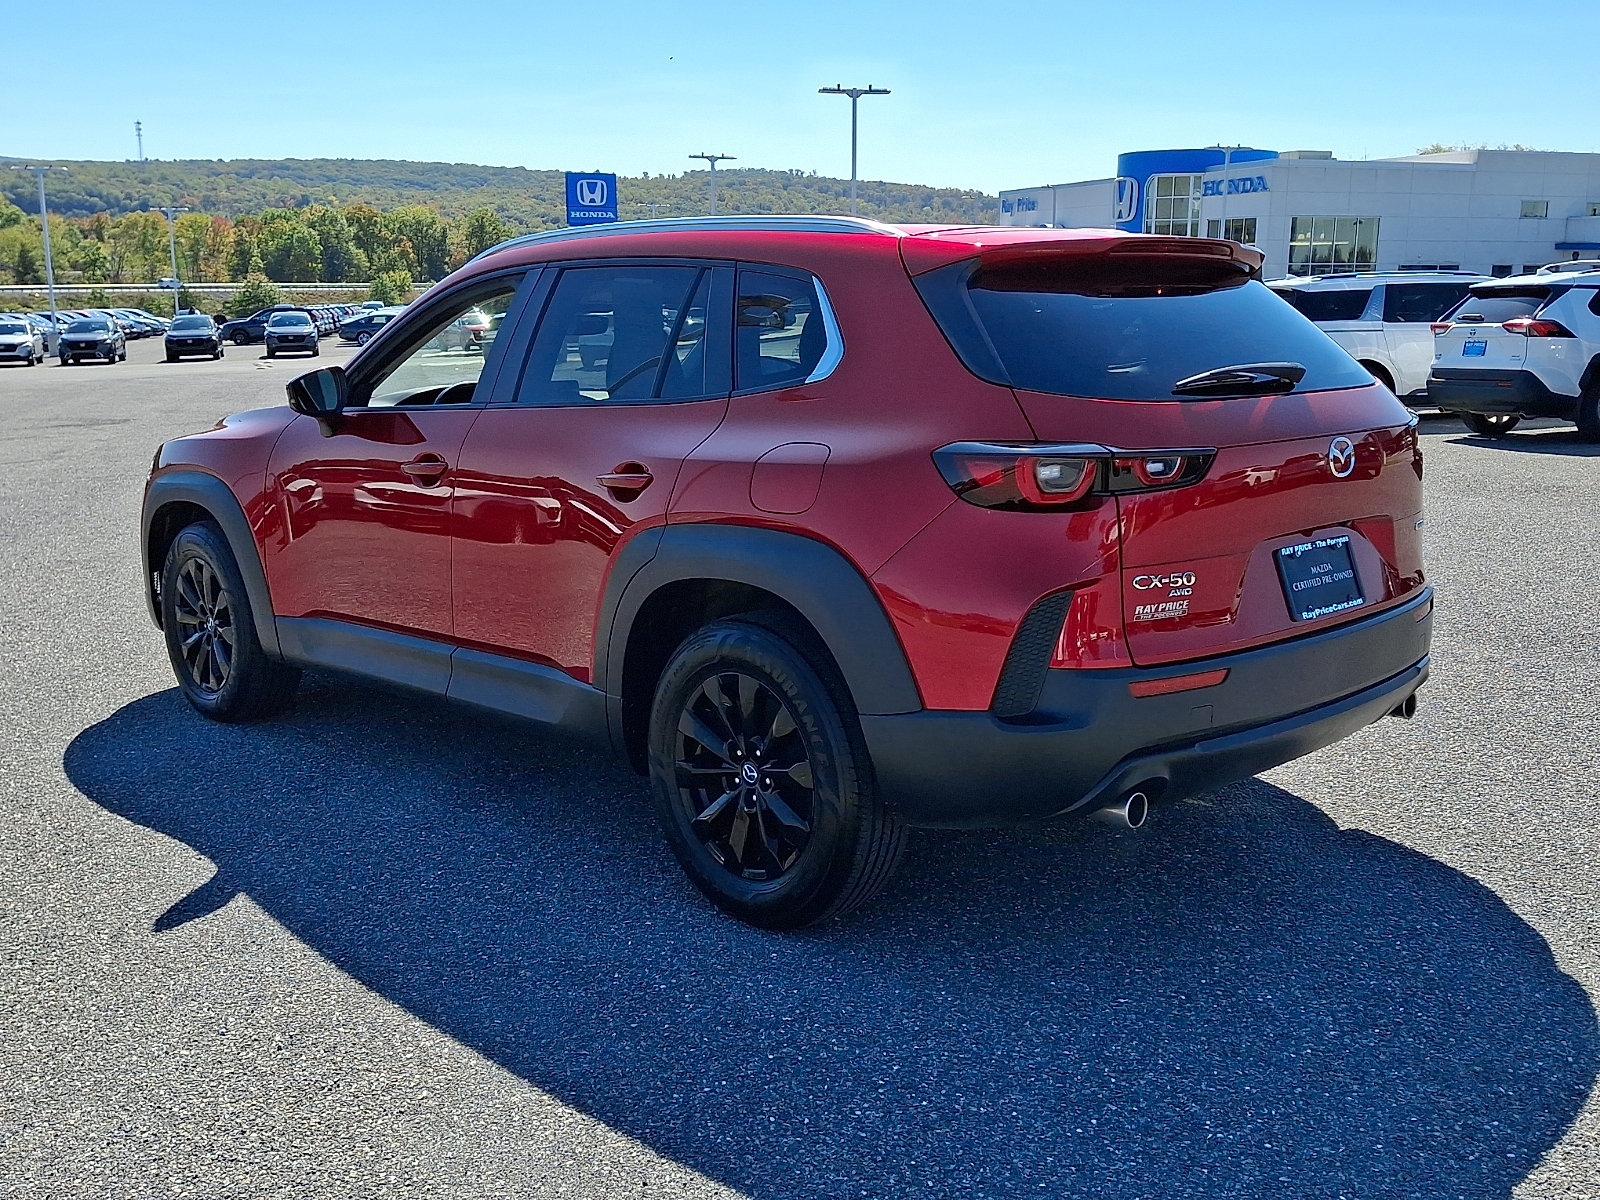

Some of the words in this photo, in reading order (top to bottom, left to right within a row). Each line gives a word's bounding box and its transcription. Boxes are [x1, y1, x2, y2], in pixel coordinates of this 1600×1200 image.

[1203, 176, 1270, 196] HONDA
[1002, 199, 1014, 216] Ray
[1017, 197, 1038, 212] Price
[1282, 546, 1294, 556] RAY
[1294, 543, 1312, 554] PRICE
[1315, 540, 1326, 548] The
[1310, 563, 1333, 575] MAZDA
[1132, 571, 1196, 590] CX-50
[1293, 578, 1322, 591] CERTIFIED
[1322, 570, 1354, 584] PRE-OWNED
[1168, 588, 1193, 597] AWD
[1135, 603, 1158, 615] RAY
[1158, 600, 1190, 612] PRICE
[1302, 598, 1363, 620] RayPriceCars.com
